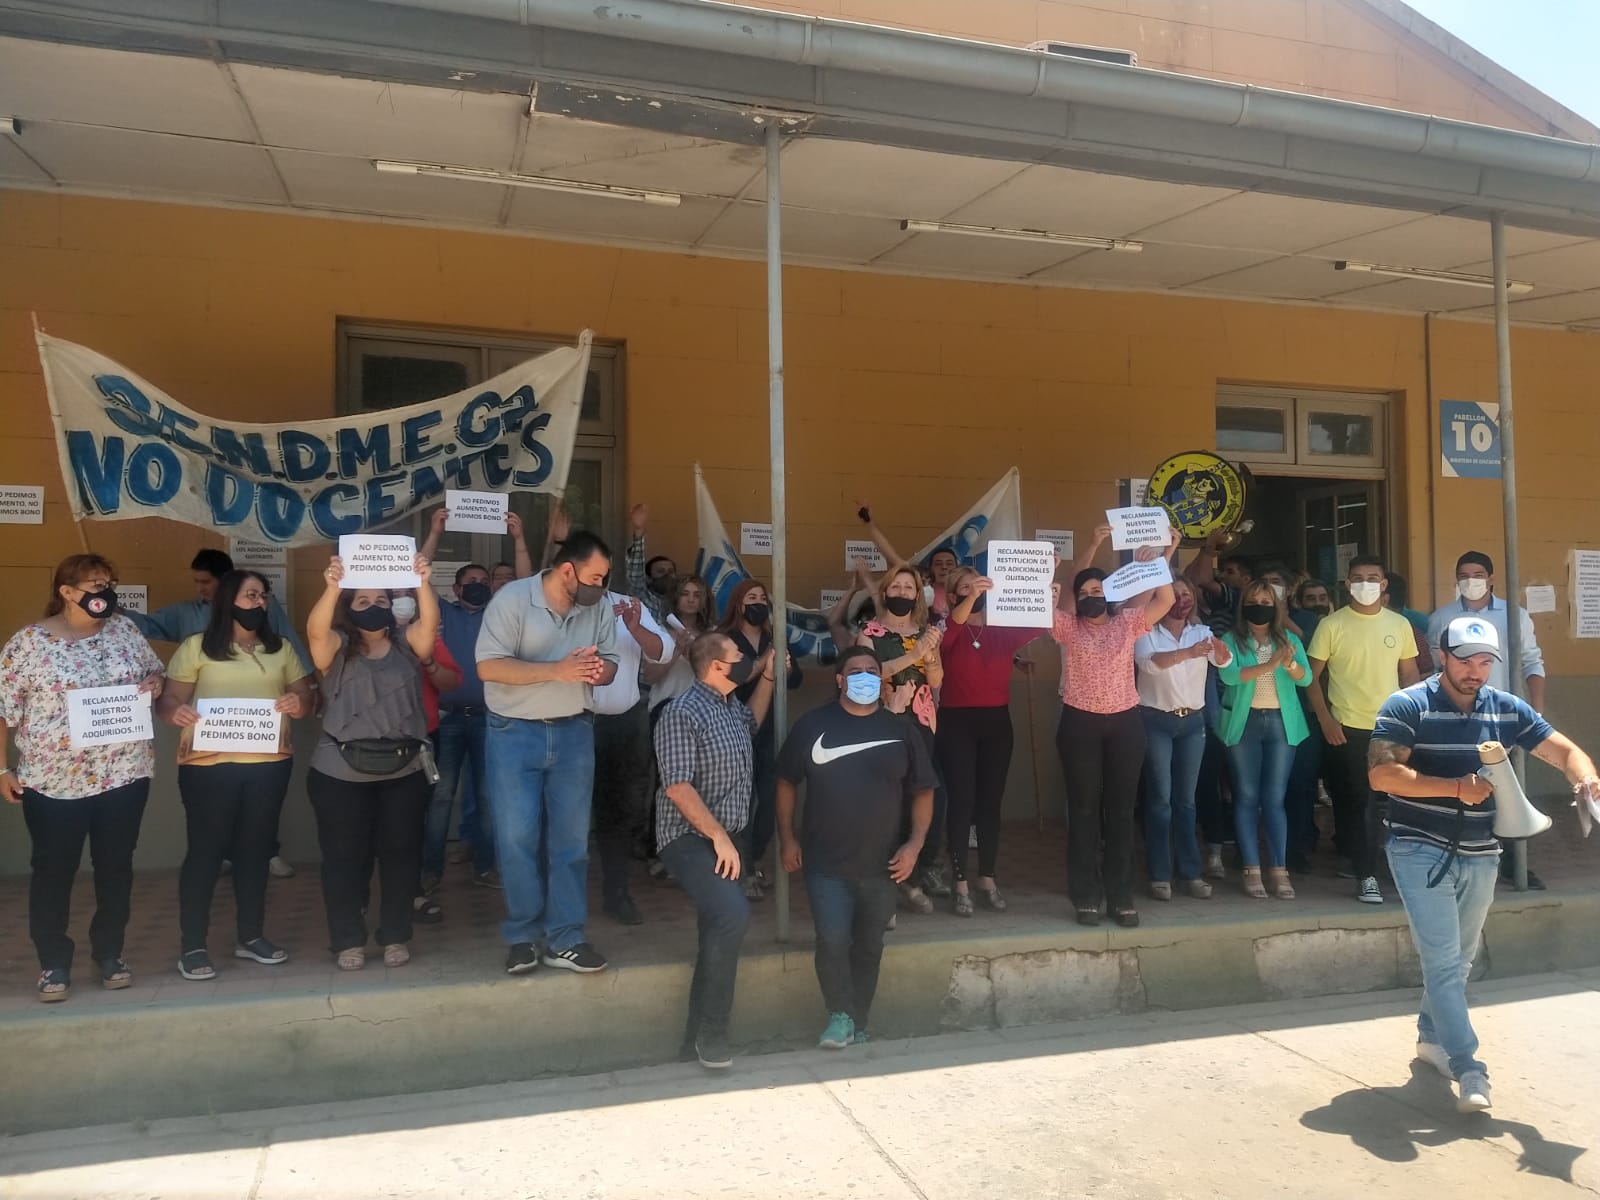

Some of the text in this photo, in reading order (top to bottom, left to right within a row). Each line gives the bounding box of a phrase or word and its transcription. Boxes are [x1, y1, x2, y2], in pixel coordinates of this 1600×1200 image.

[1451, 421, 1493, 452] 10
[66, 412, 555, 543] NO DOCENTES
[1120, 512, 1162, 520] RECLAMAMOS
[1125, 536, 1162, 544] ADQUIRIDOS
[82, 694, 139, 706] RECLAMAMOS
[91, 706, 132, 716] NUESTROS
[227, 708, 272, 716] PEDIMOS
[92, 716, 133, 727] DERECHOS
[204, 719, 257, 729] AUMENTO,
[200, 731, 276, 741] PEDIMOS BONO
